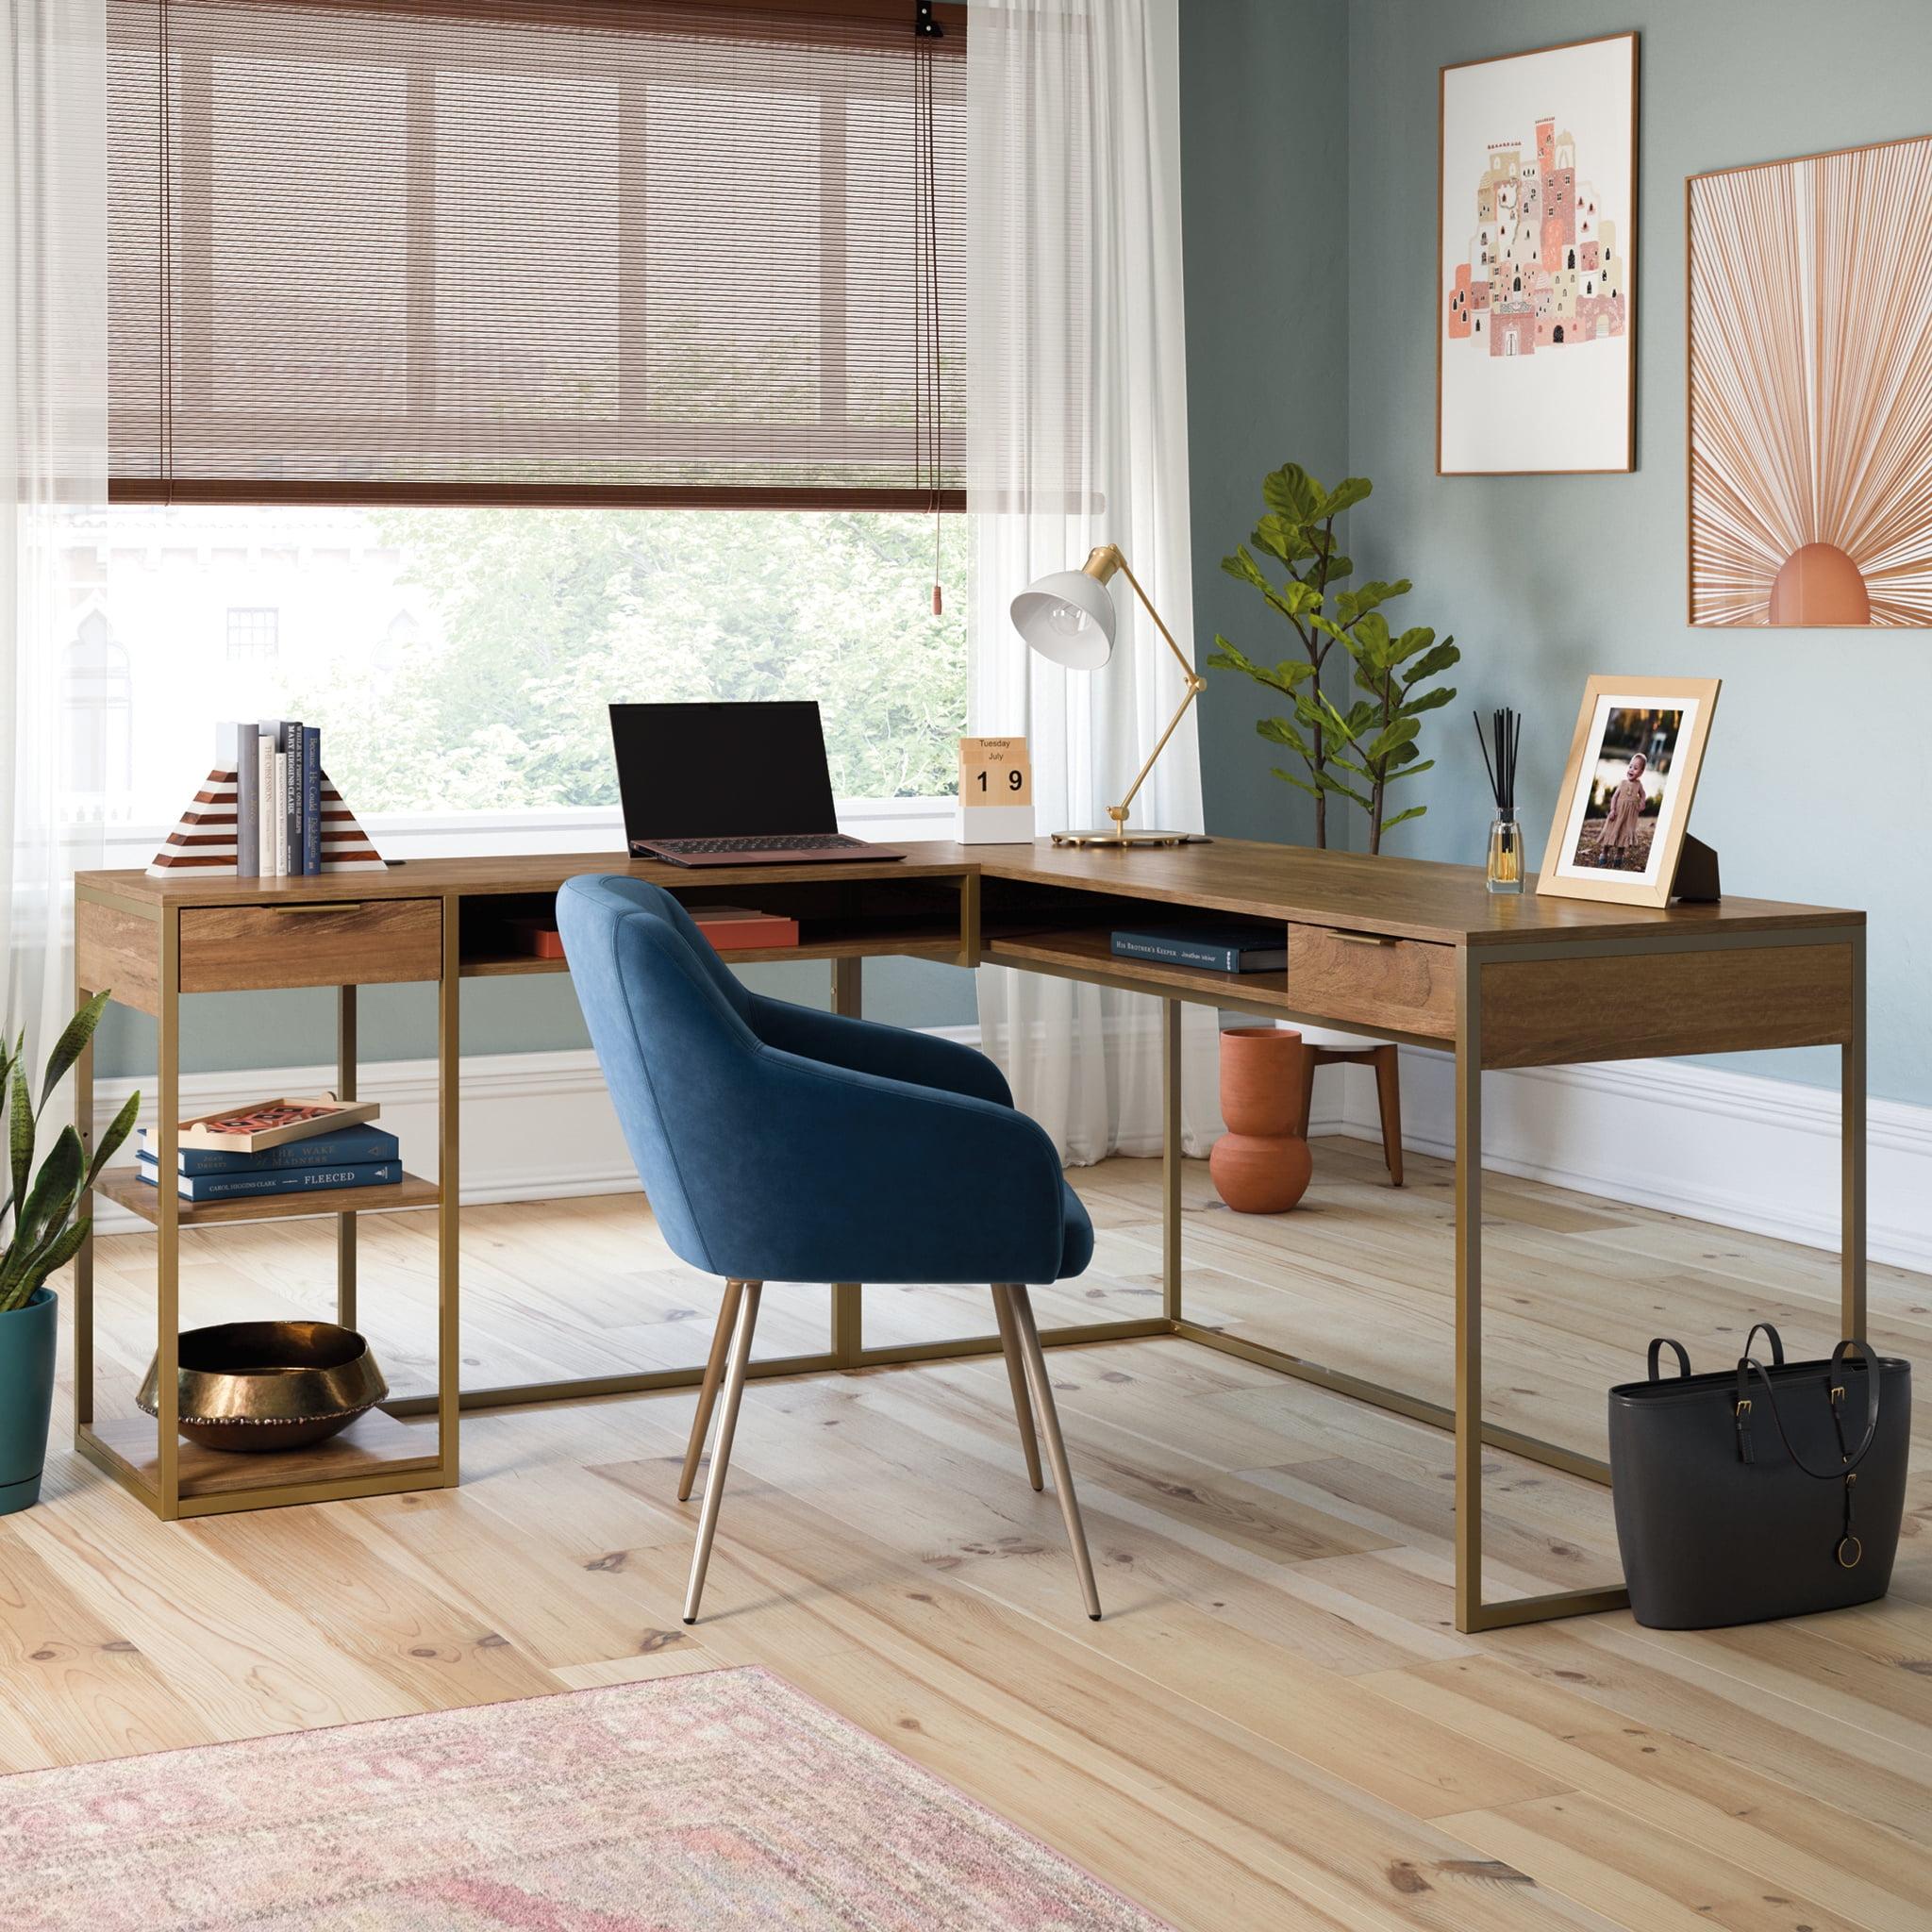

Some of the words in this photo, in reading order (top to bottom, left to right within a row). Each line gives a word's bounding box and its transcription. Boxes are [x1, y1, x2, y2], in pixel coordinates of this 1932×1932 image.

[979, 740, 1010, 748] Tuesday
[296, 752, 302, 763] MY
[308, 738, 318, 768] Because
[989, 753, 1004, 761] July
[308, 772, 318, 784] He
[977, 771, 987, 791] 1
[1008, 770, 1023, 791] 9
[308, 786, 318, 811] Could
[302, 1145, 334, 1156] WAKE
[305, 1172, 355, 1185] FLEECED
